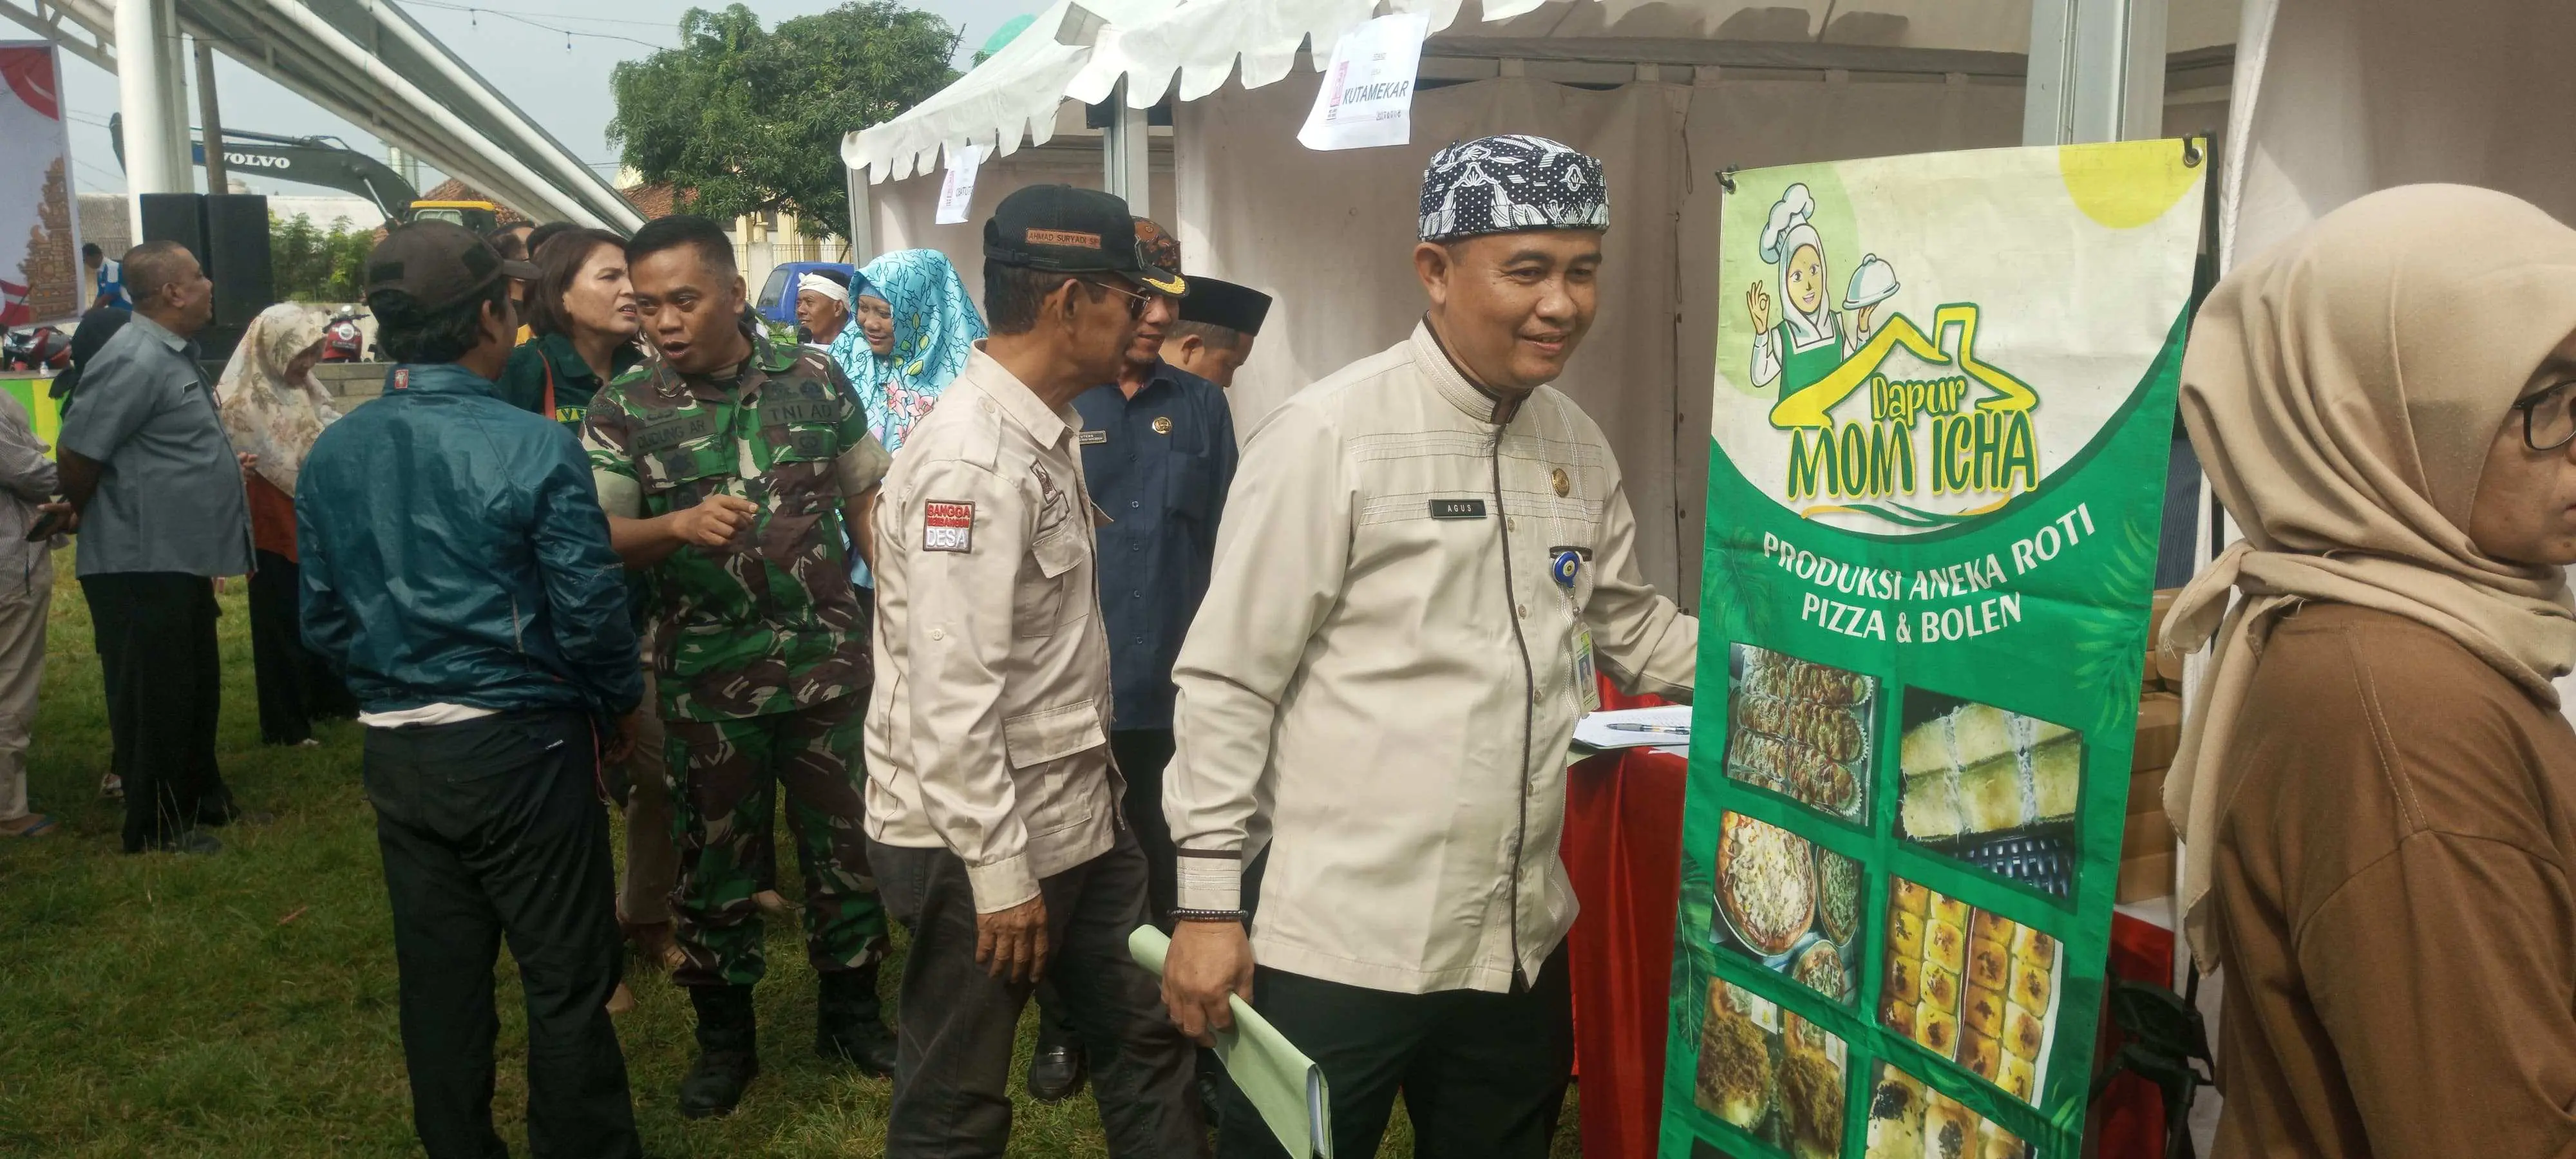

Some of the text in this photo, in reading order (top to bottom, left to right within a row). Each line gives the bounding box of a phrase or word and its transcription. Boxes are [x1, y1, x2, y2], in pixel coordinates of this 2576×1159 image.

[1342, 80, 1409, 105] KUTAMEKAR
[1028, 232, 1054, 241] AHMAD
[1057, 234, 1087, 244] SURYADI
[1871, 373, 1968, 429] Dapur
[769, 404, 832, 422] TNI AD
[1787, 410, 2039, 500] MOM ICHA
[927, 504, 970, 518] BANGGA
[1447, 504, 1472, 513] AGUS
[926, 528, 969, 549] DESA
[1763, 502, 2096, 601] PRODUKSI ANEKA ROTI
[1801, 591, 2022, 644] PIZZA & BOLEN
